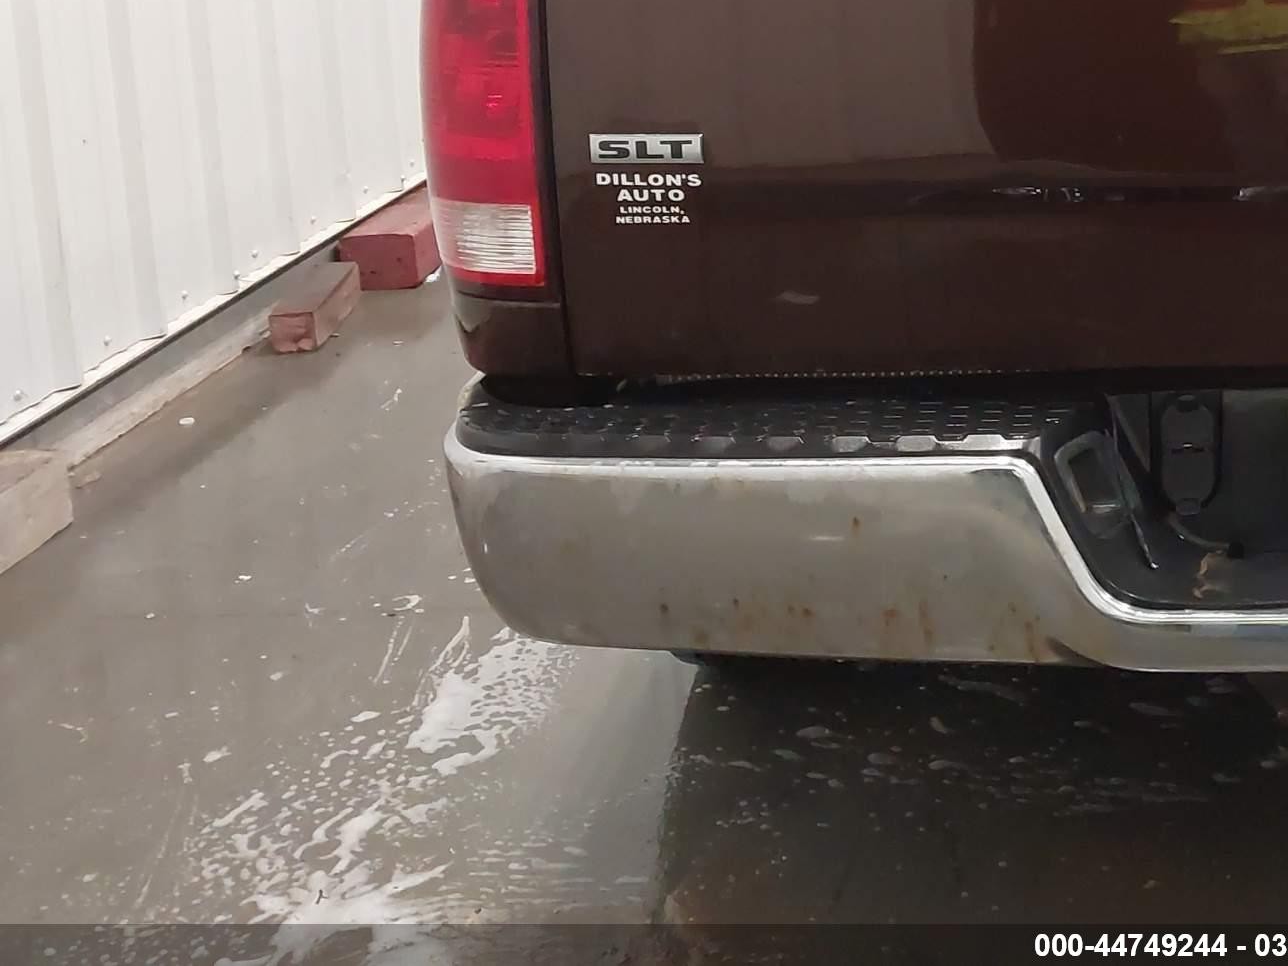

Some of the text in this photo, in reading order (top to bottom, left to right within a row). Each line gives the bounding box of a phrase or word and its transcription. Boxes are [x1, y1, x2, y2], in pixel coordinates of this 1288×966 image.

[598, 140, 692, 159] SLT
[596, 173, 701, 186] DILLON'S
[617, 189, 685, 201] AUTO
[619, 206, 685, 214] LINCOLN,
[616, 216, 690, 224] NEBRASKA
